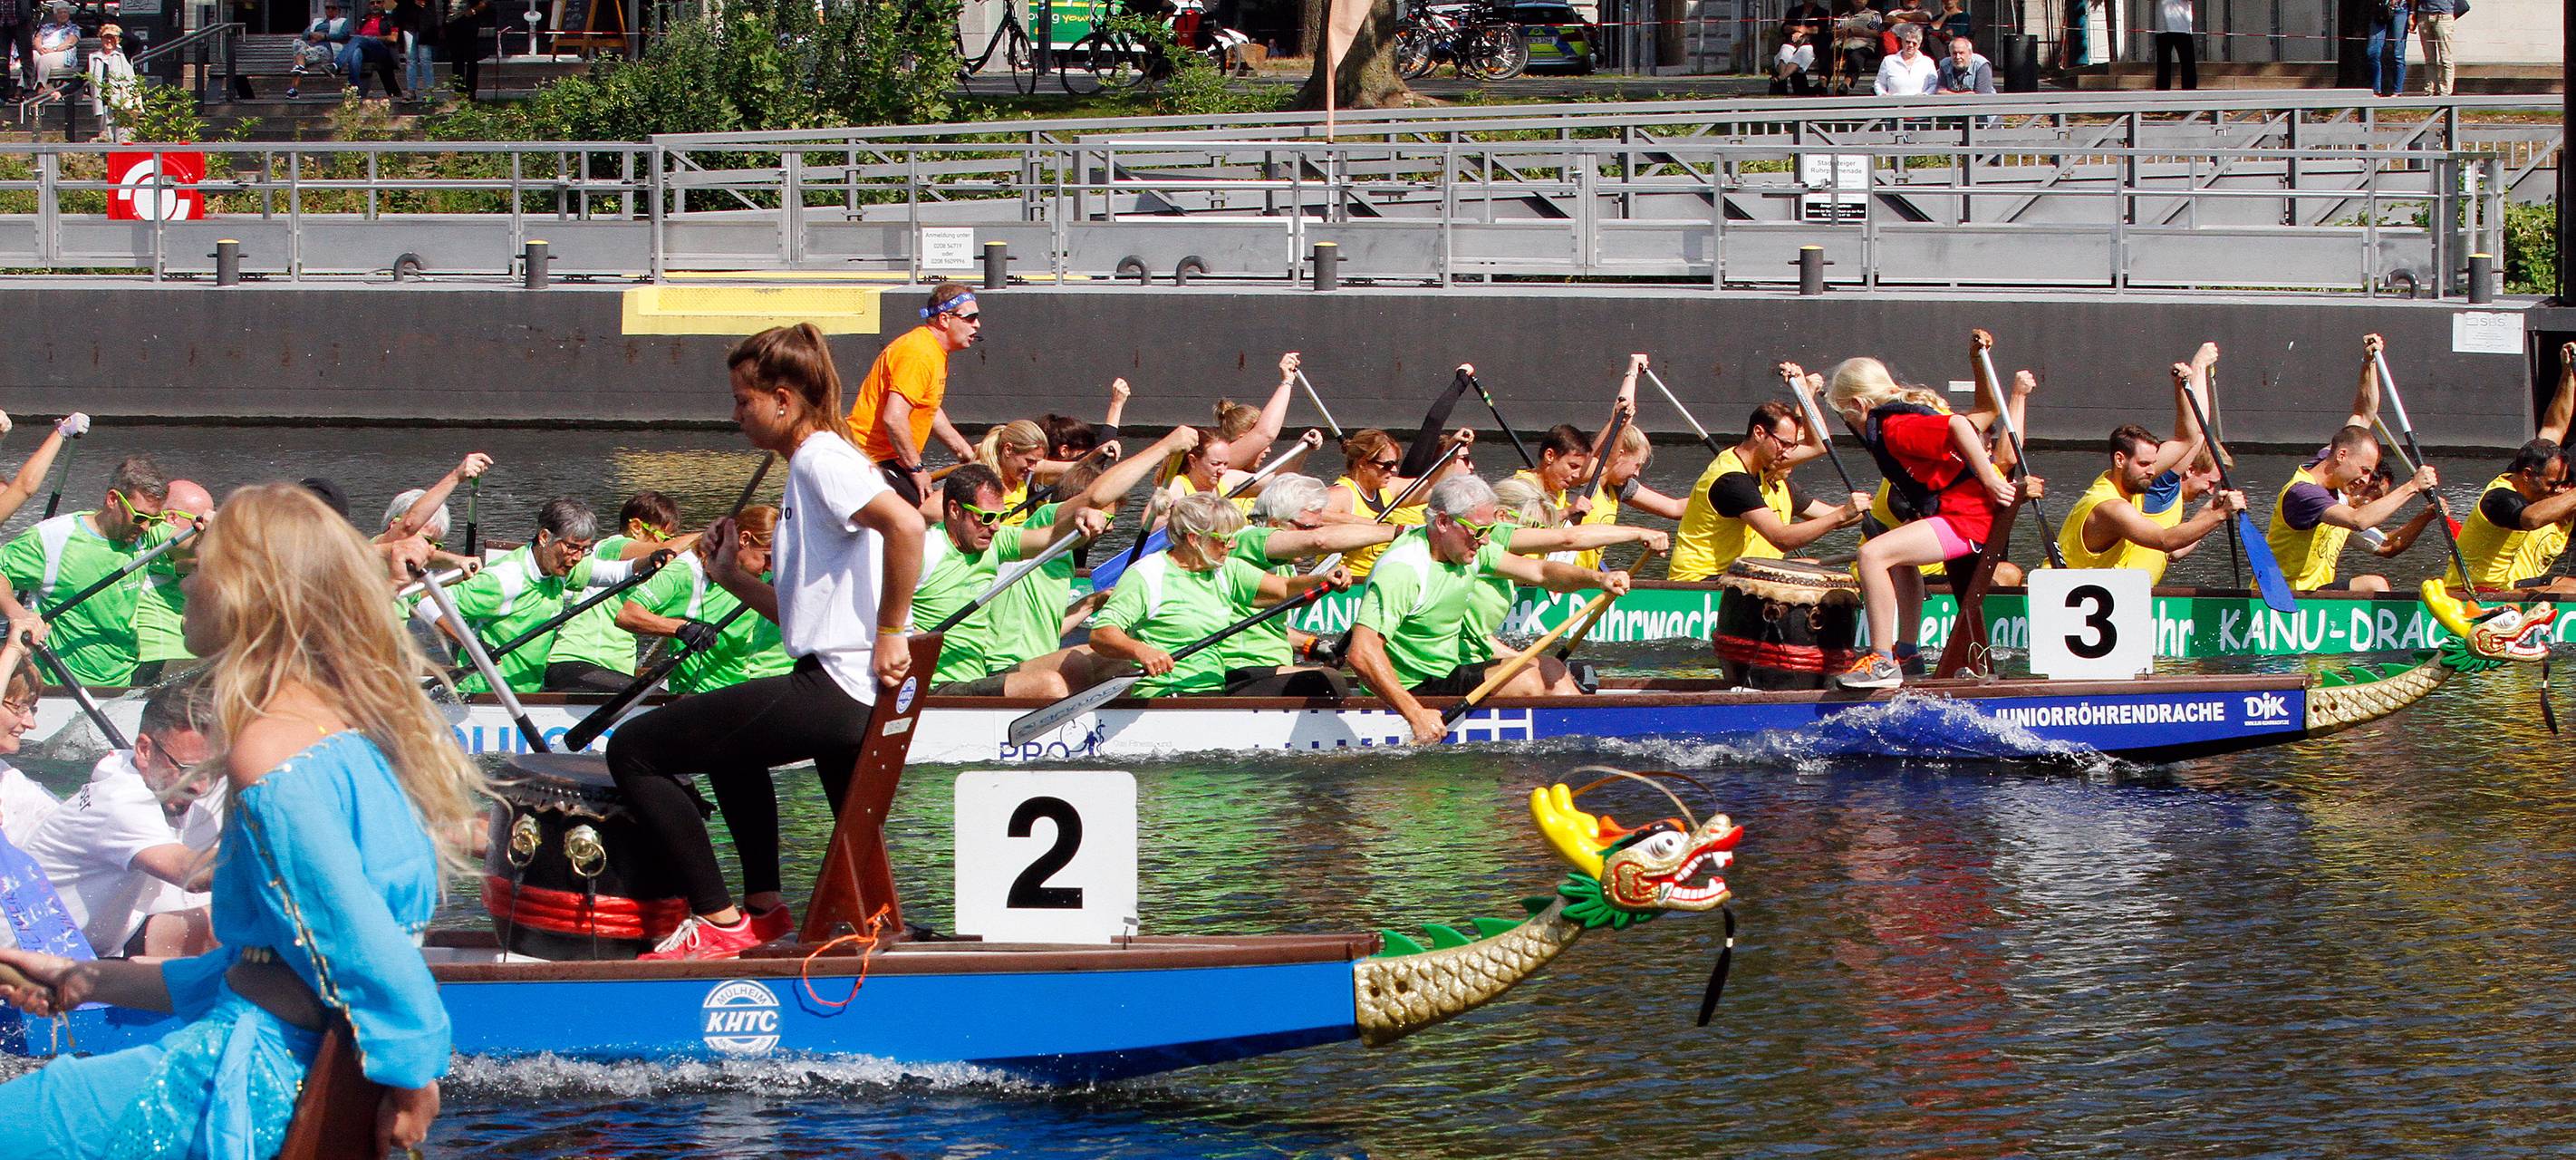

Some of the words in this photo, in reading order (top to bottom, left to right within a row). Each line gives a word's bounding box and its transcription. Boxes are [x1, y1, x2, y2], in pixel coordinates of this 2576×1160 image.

[1063, 14, 1089, 24] your
[2064, 585, 2118, 659] 3
[1007, 796, 1084, 910] 2
[705, 1010, 779, 1032] KHTC
